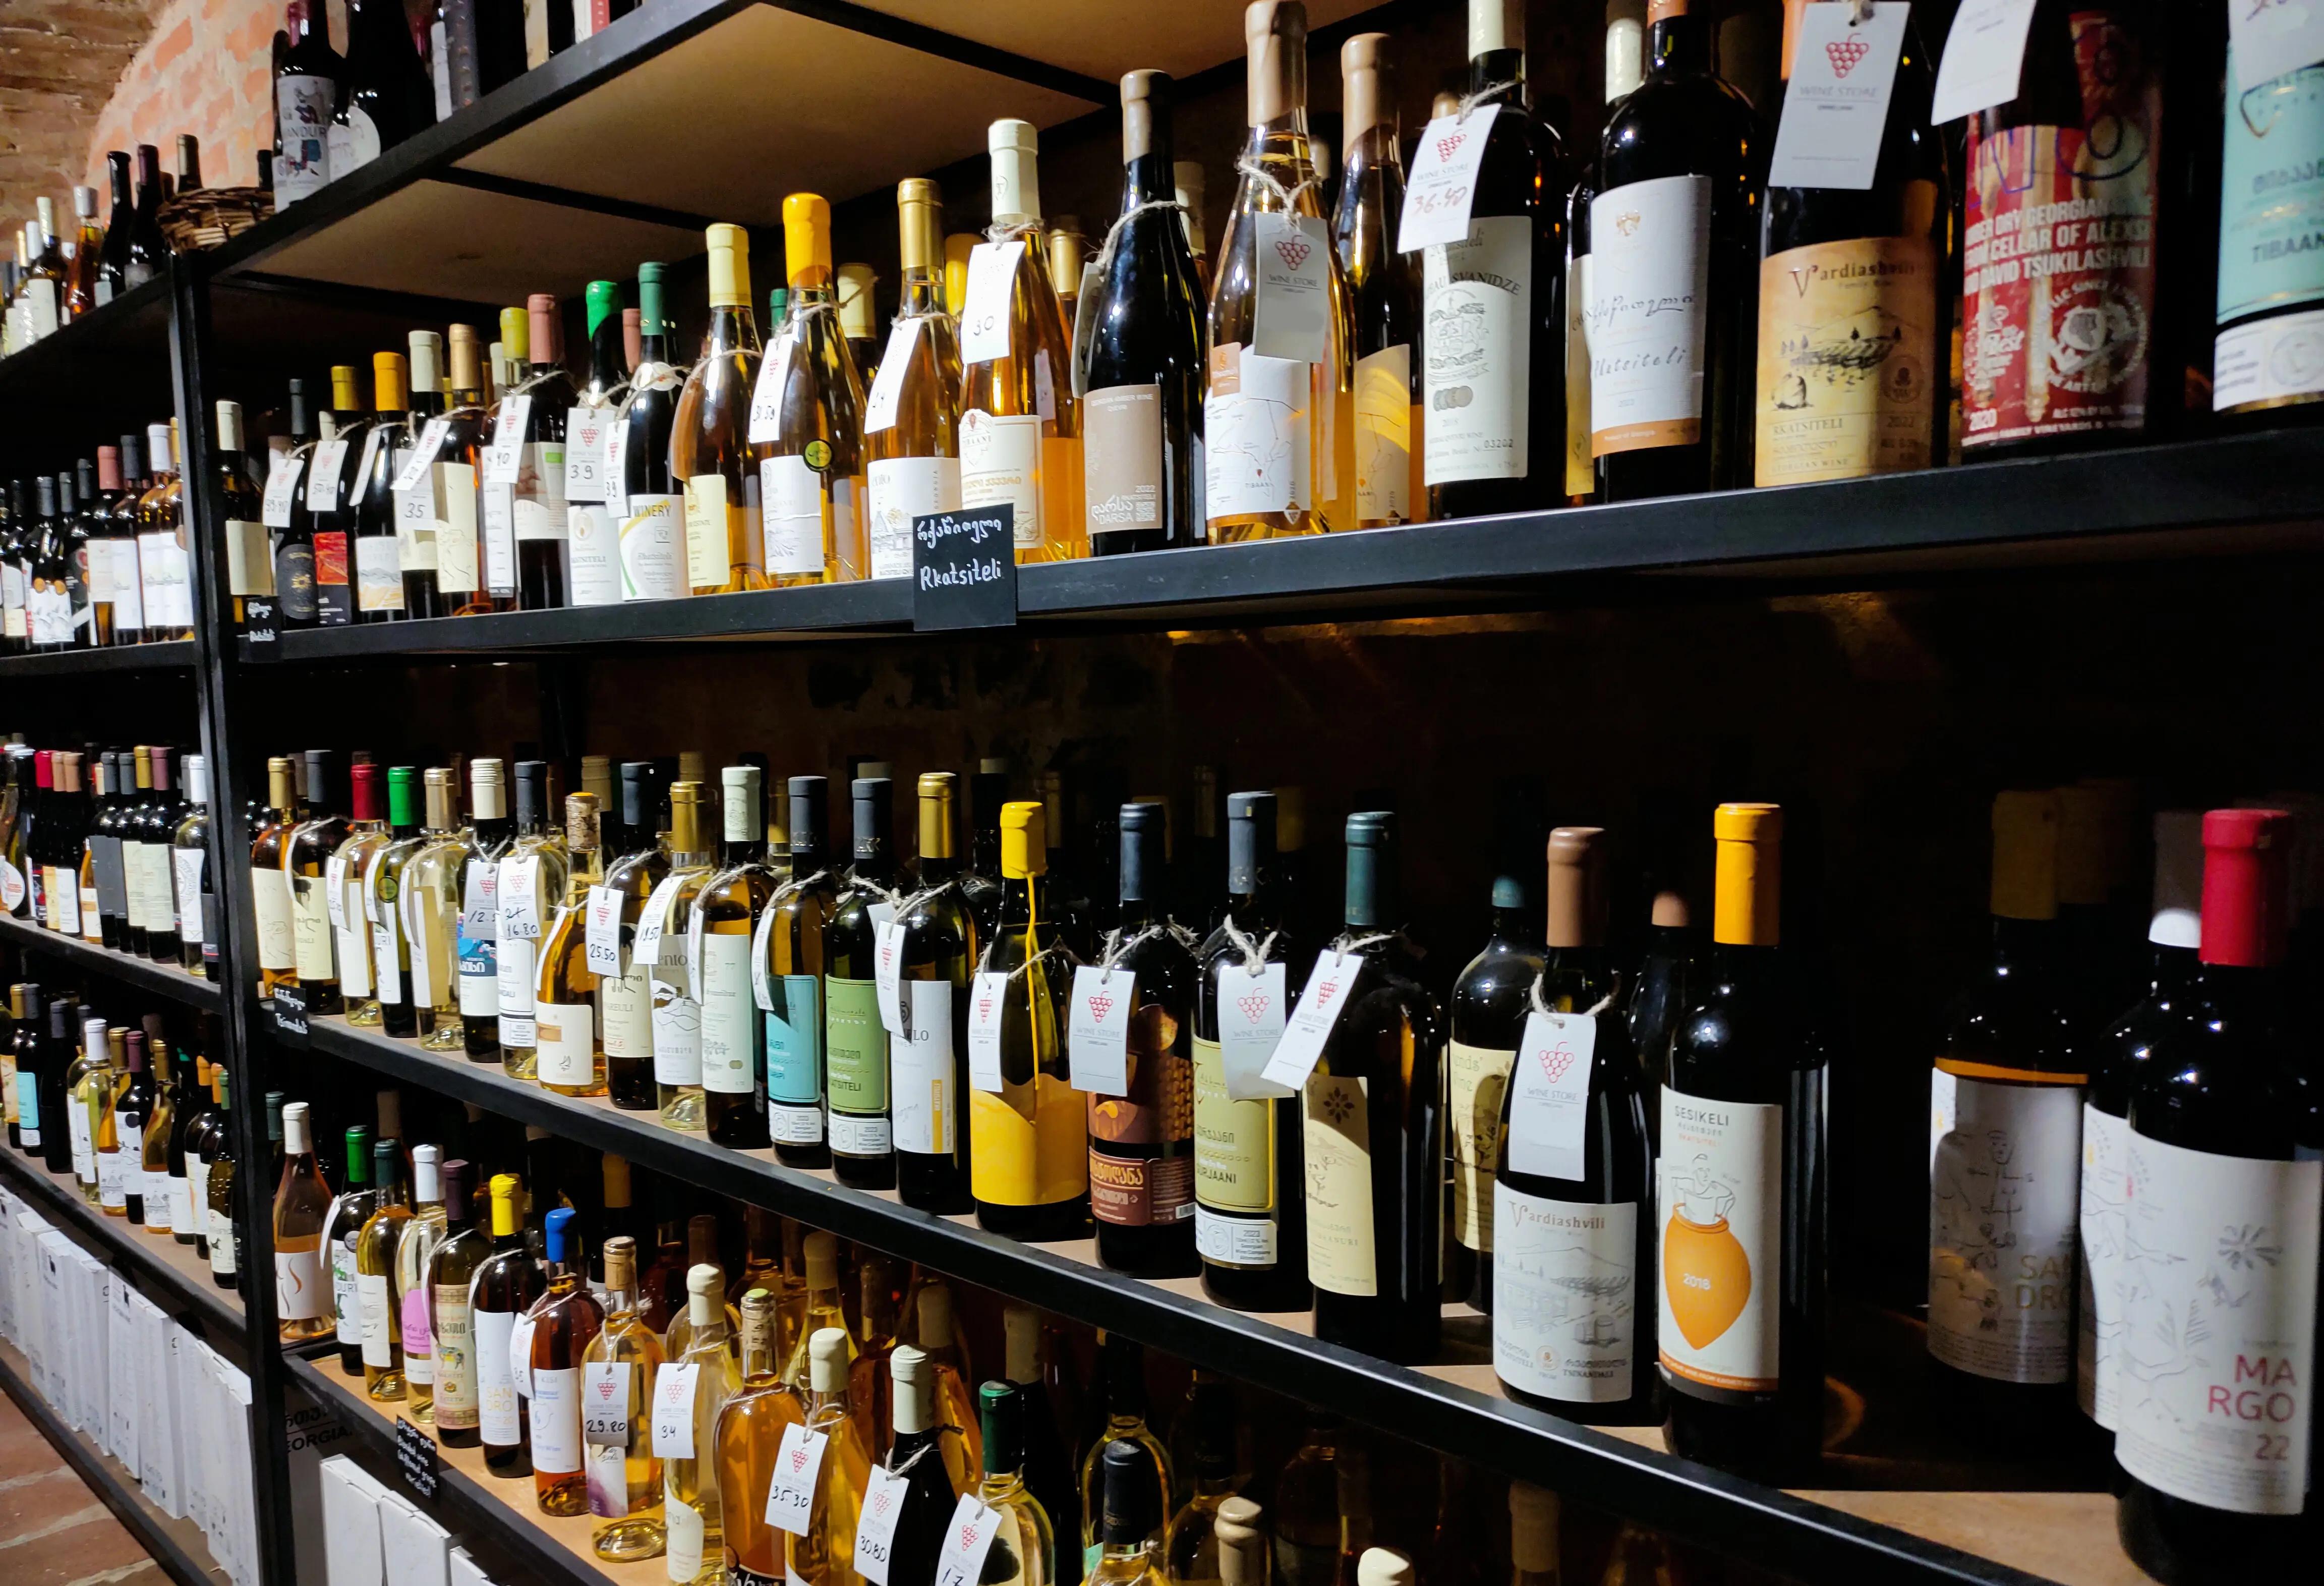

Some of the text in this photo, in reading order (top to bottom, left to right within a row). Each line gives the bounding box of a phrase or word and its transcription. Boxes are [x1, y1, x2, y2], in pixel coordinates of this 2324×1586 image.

[1990, 229, 2051, 261] CELLAR
[2056, 223, 2079, 247] OF
[1269, 274, 1317, 288] WINE STORE
[1451, 271, 1522, 297] SVANIDZE
[973, 315, 995, 336] 30
[404, 502, 426, 519] 35
[633, 504, 671, 517] WINERY
[1098, 513, 1134, 525] DARSA
[917, 516, 1002, 549] რქაწითელი
[920, 558, 1002, 591] Rkatsiteli
[506, 924, 538, 935] 16.80
[590, 943, 616, 962] 25.50
[1076, 1027, 1120, 1038] WINE STORE
[1255, 1029, 1281, 1037] STORE
[1527, 1088, 1578, 1101] WINE STORE
[1674, 1105, 1729, 1126] SESIKELI
[1508, 1201, 1605, 1230] Vardiashvili
[2234, 1354, 2297, 1387] MA
[486, 1387, 513, 1398] SAN
[486, 1399, 513, 1412] DRO
[2207, 1385, 2295, 1423] RGO
[586, 1419, 627, 1433] 29.80
[2255, 1433, 2290, 1460] 22
[771, 1485, 809, 1508] 35.30
